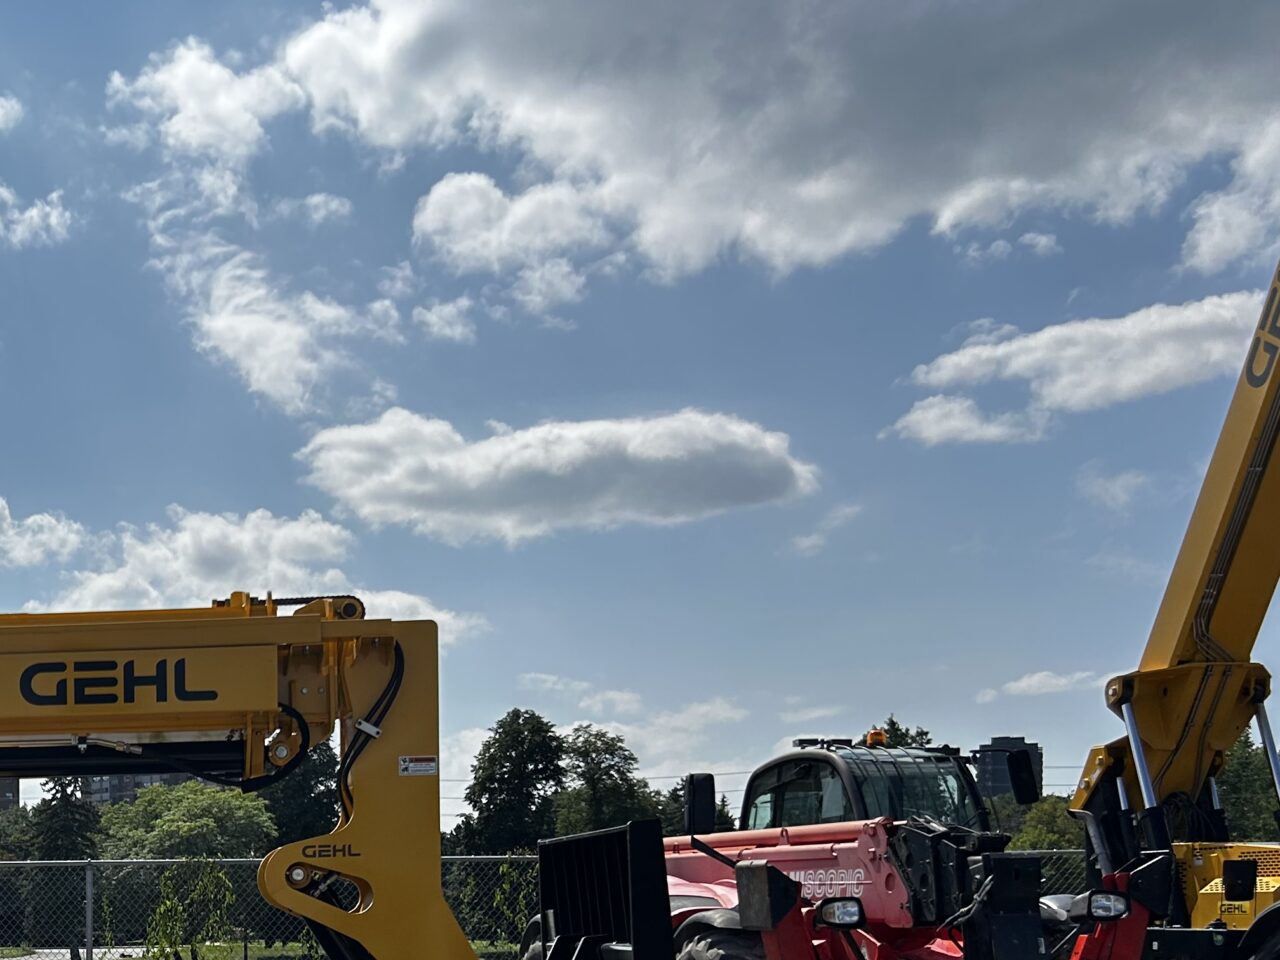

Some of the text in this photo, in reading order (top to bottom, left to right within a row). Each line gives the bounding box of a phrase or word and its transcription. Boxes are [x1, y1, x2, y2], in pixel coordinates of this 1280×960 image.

[19, 657, 219, 707] GEHL
[301, 844, 361, 858] GEHL
[1219, 904, 1247, 914] GEHL
